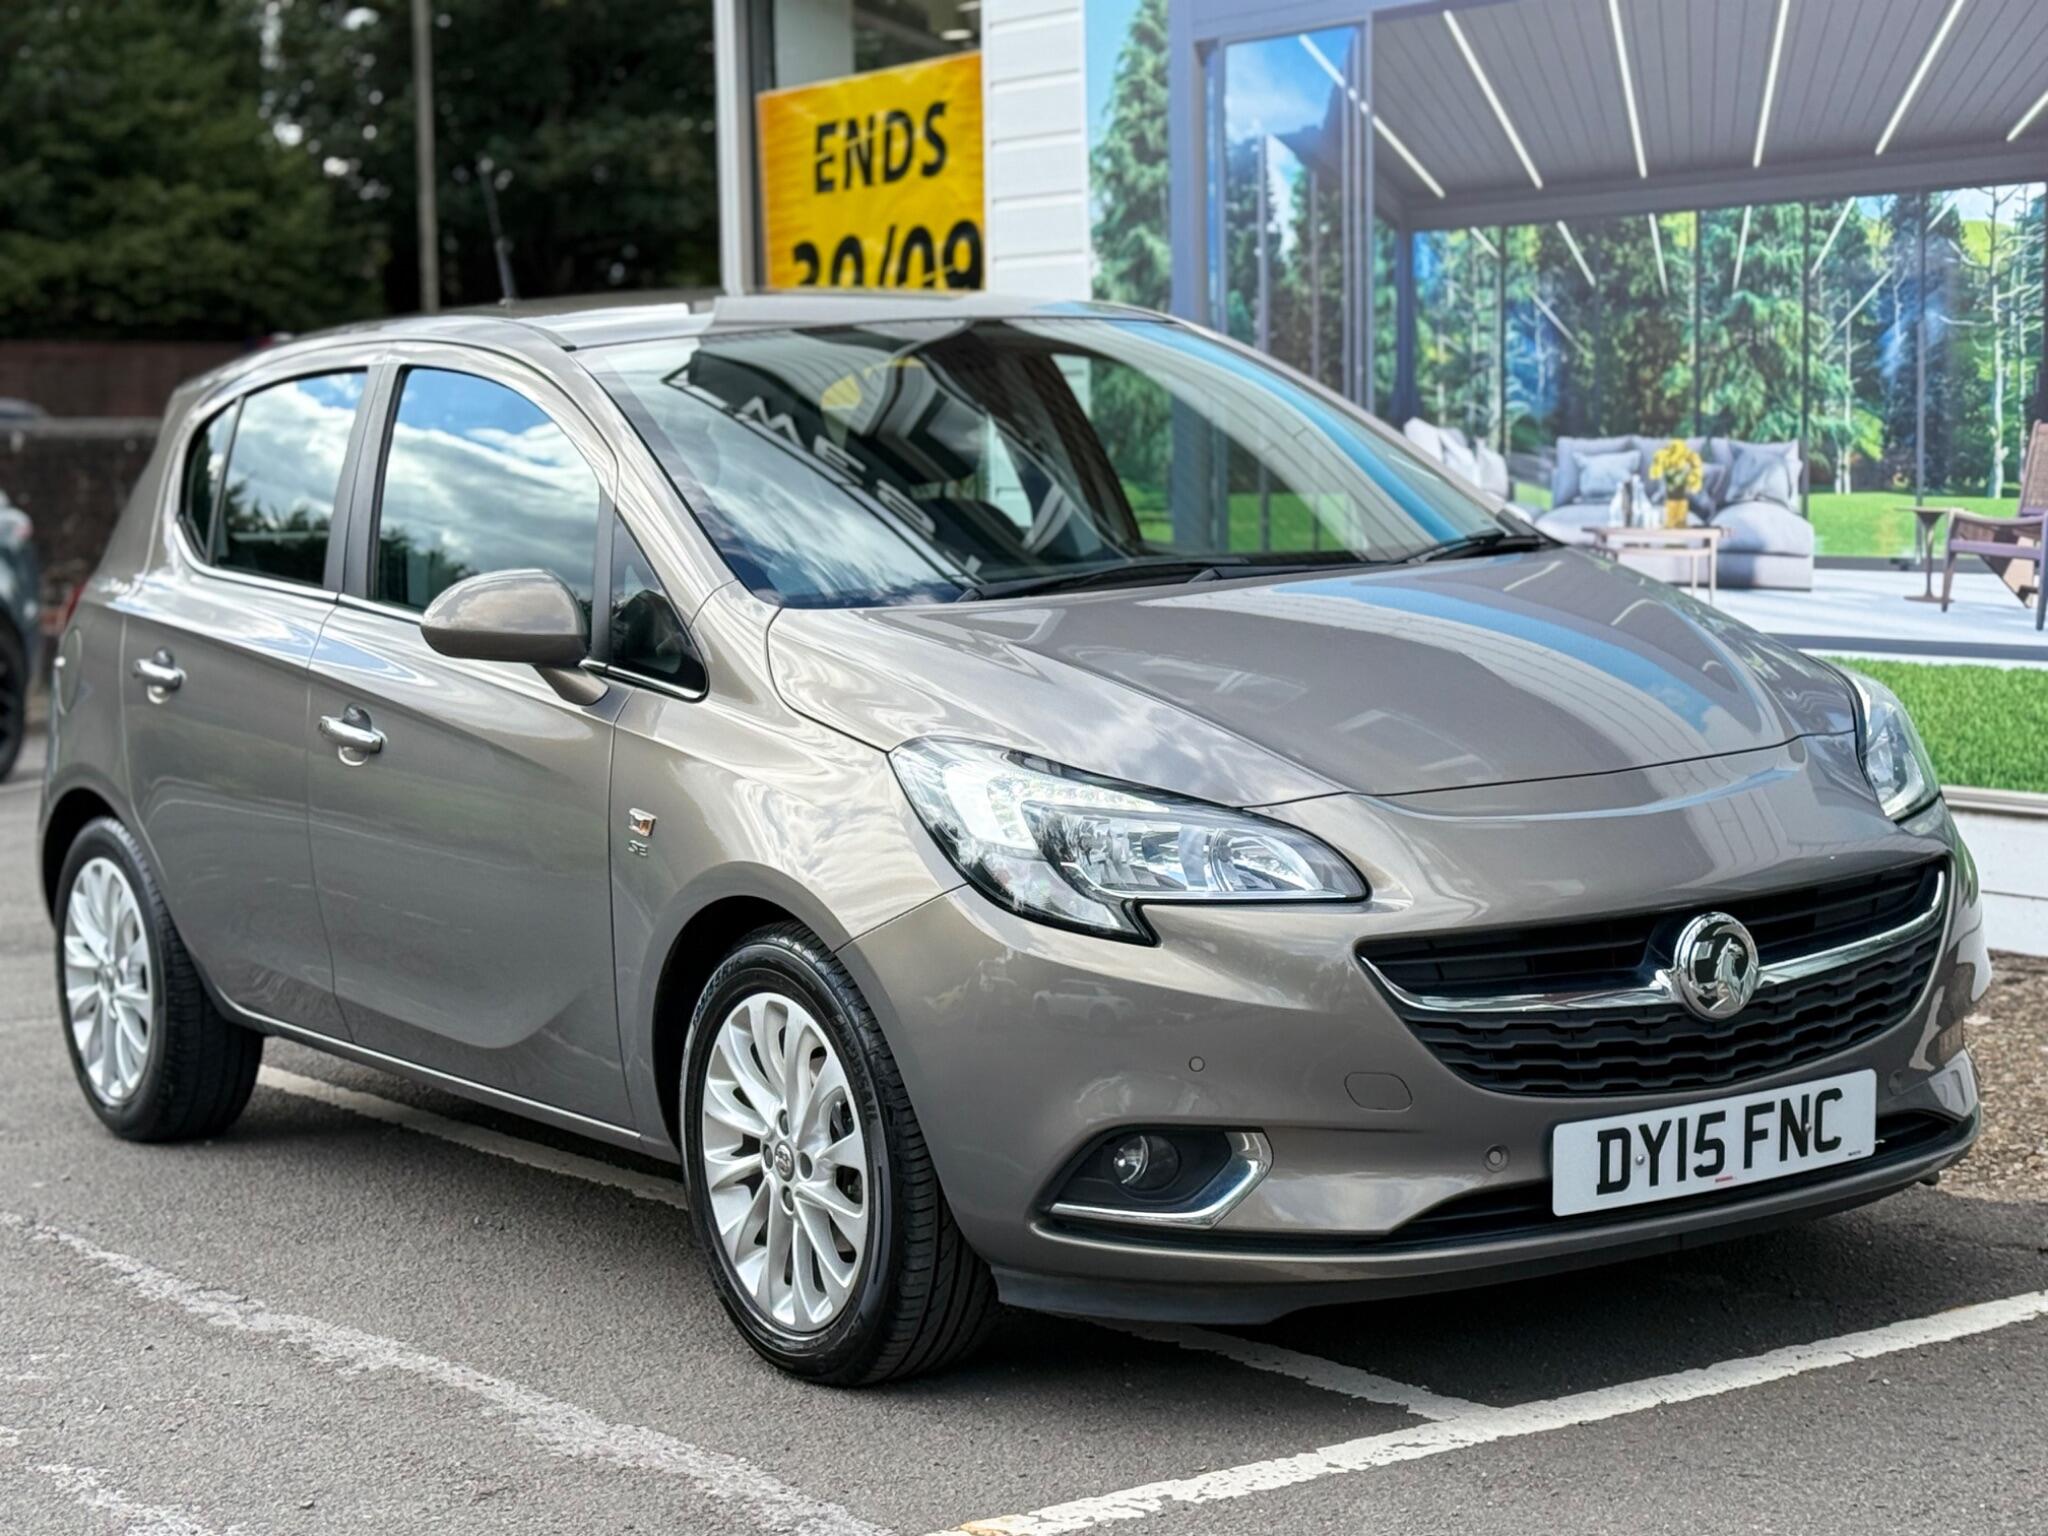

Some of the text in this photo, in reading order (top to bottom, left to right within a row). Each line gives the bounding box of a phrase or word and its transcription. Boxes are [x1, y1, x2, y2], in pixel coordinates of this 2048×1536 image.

[815, 101, 946, 194] ENDS
[1597, 1087, 1843, 1196] DY15 FNC
